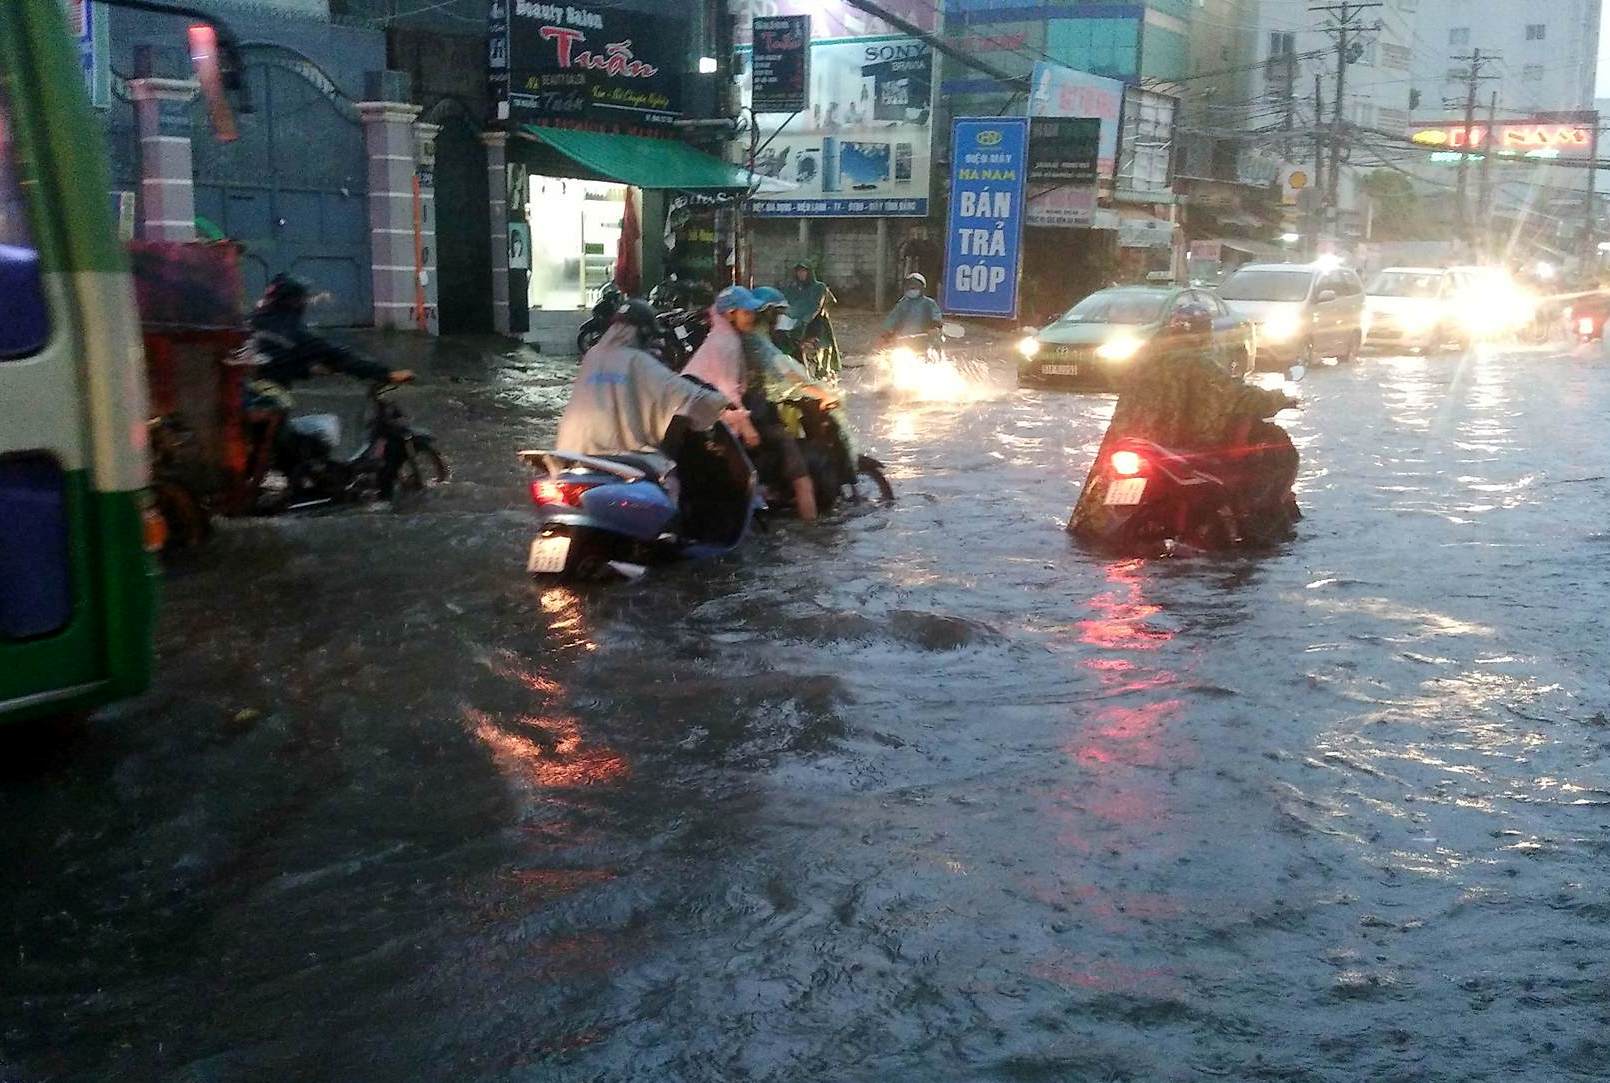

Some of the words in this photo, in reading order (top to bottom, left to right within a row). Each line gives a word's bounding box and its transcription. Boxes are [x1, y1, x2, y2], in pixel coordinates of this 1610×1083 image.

[864, 44, 928, 61] SONY
[959, 187, 1012, 219] BÁN
[958, 222, 1006, 257] TRẢ
[955, 261, 1006, 294] GÓP
